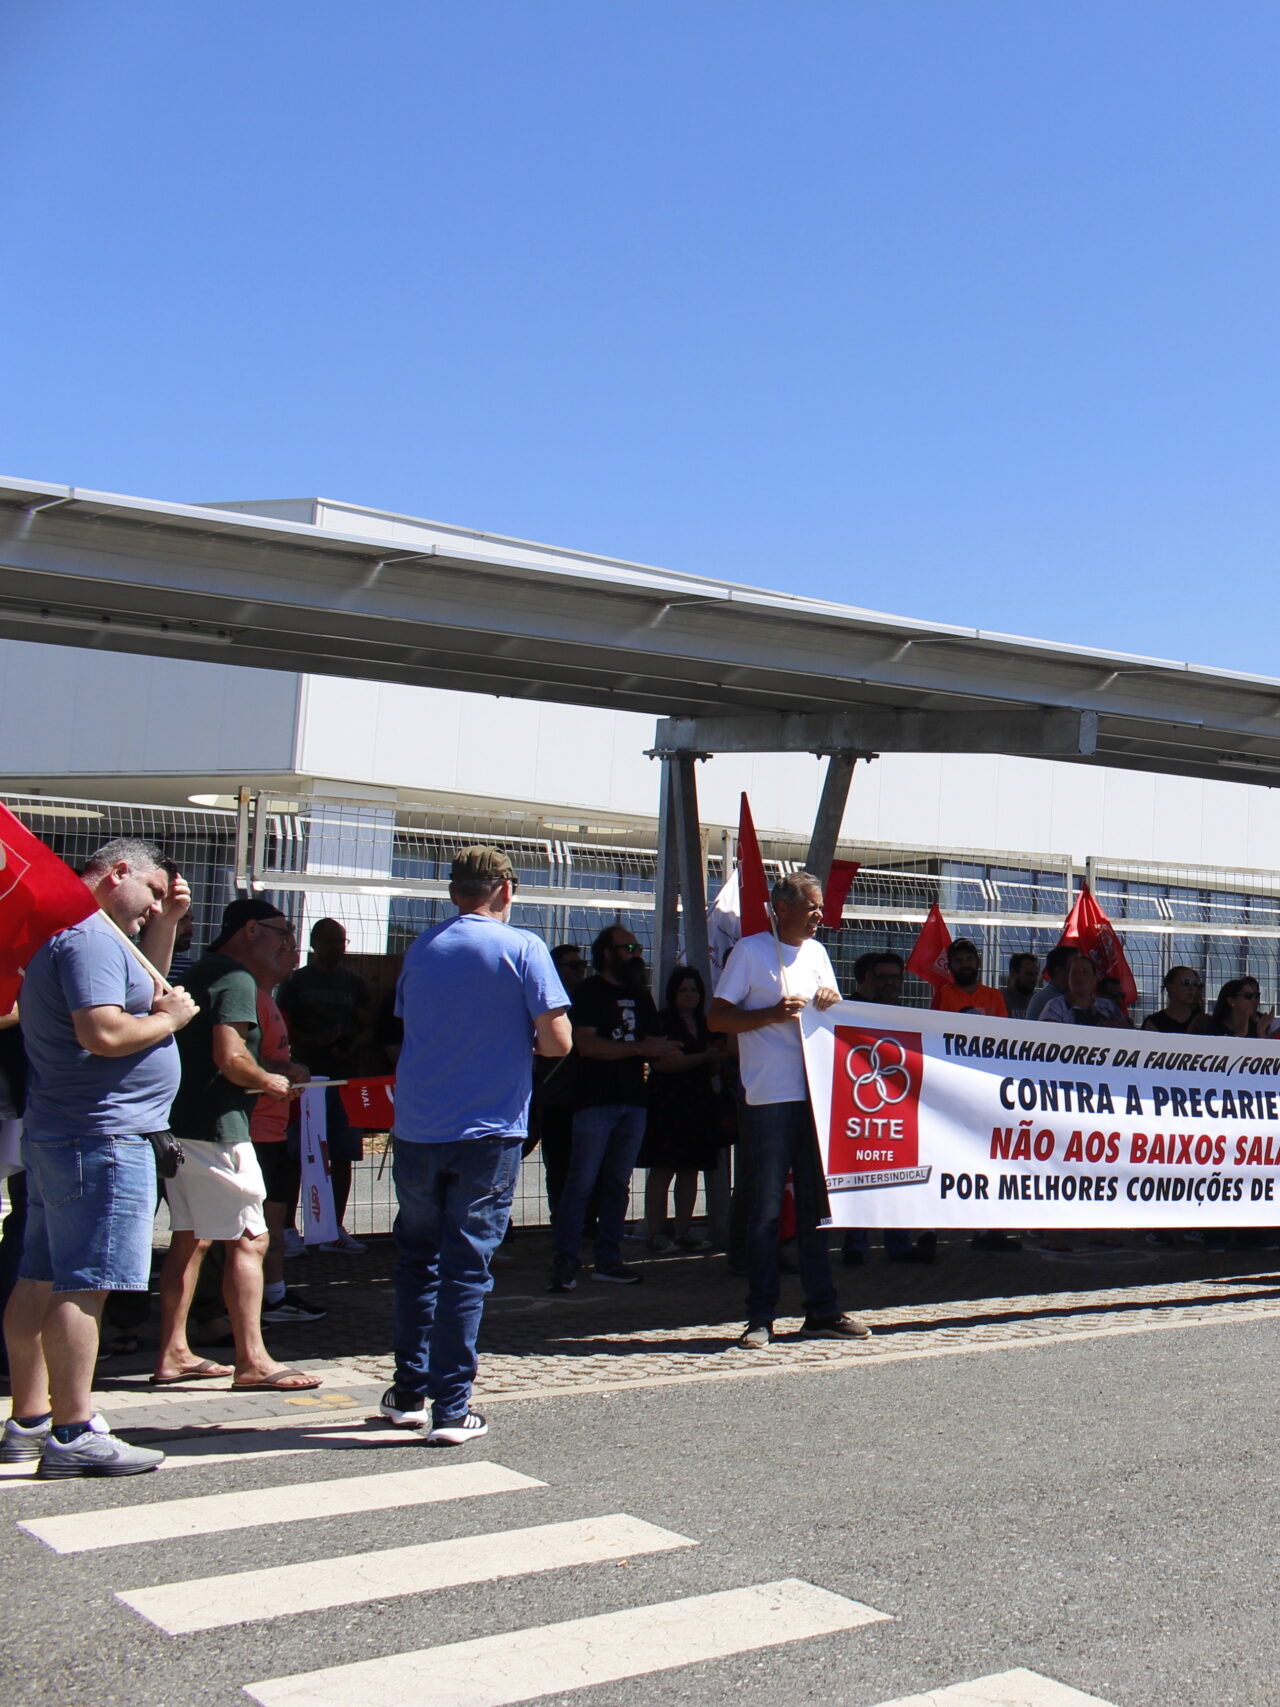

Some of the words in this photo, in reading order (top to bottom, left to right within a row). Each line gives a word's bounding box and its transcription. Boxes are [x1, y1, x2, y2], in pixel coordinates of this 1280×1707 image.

[942, 1032, 1111, 1067] TRABALHADORES
[1111, 1048, 1141, 1069] DA
[999, 1076, 1115, 1114] CONTRA
[1125, 1084, 1143, 1116] A
[845, 1116, 905, 1140] SITE
[990, 1119, 1055, 1162] NÃO
[1063, 1130, 1121, 1164] AOS
[1129, 1133, 1227, 1166] BAIXOS
[856, 1149, 894, 1162] NORTE
[826, 1177, 844, 1187] GTP
[854, 1170, 926, 1185] INTERSINDICAL
[940, 1173, 989, 1200] POR
[998, 1174, 1119, 1202] MELHORES
[1126, 1171, 1244, 1206] CONDIÇÕES
[1250, 1177, 1275, 1201] DE
